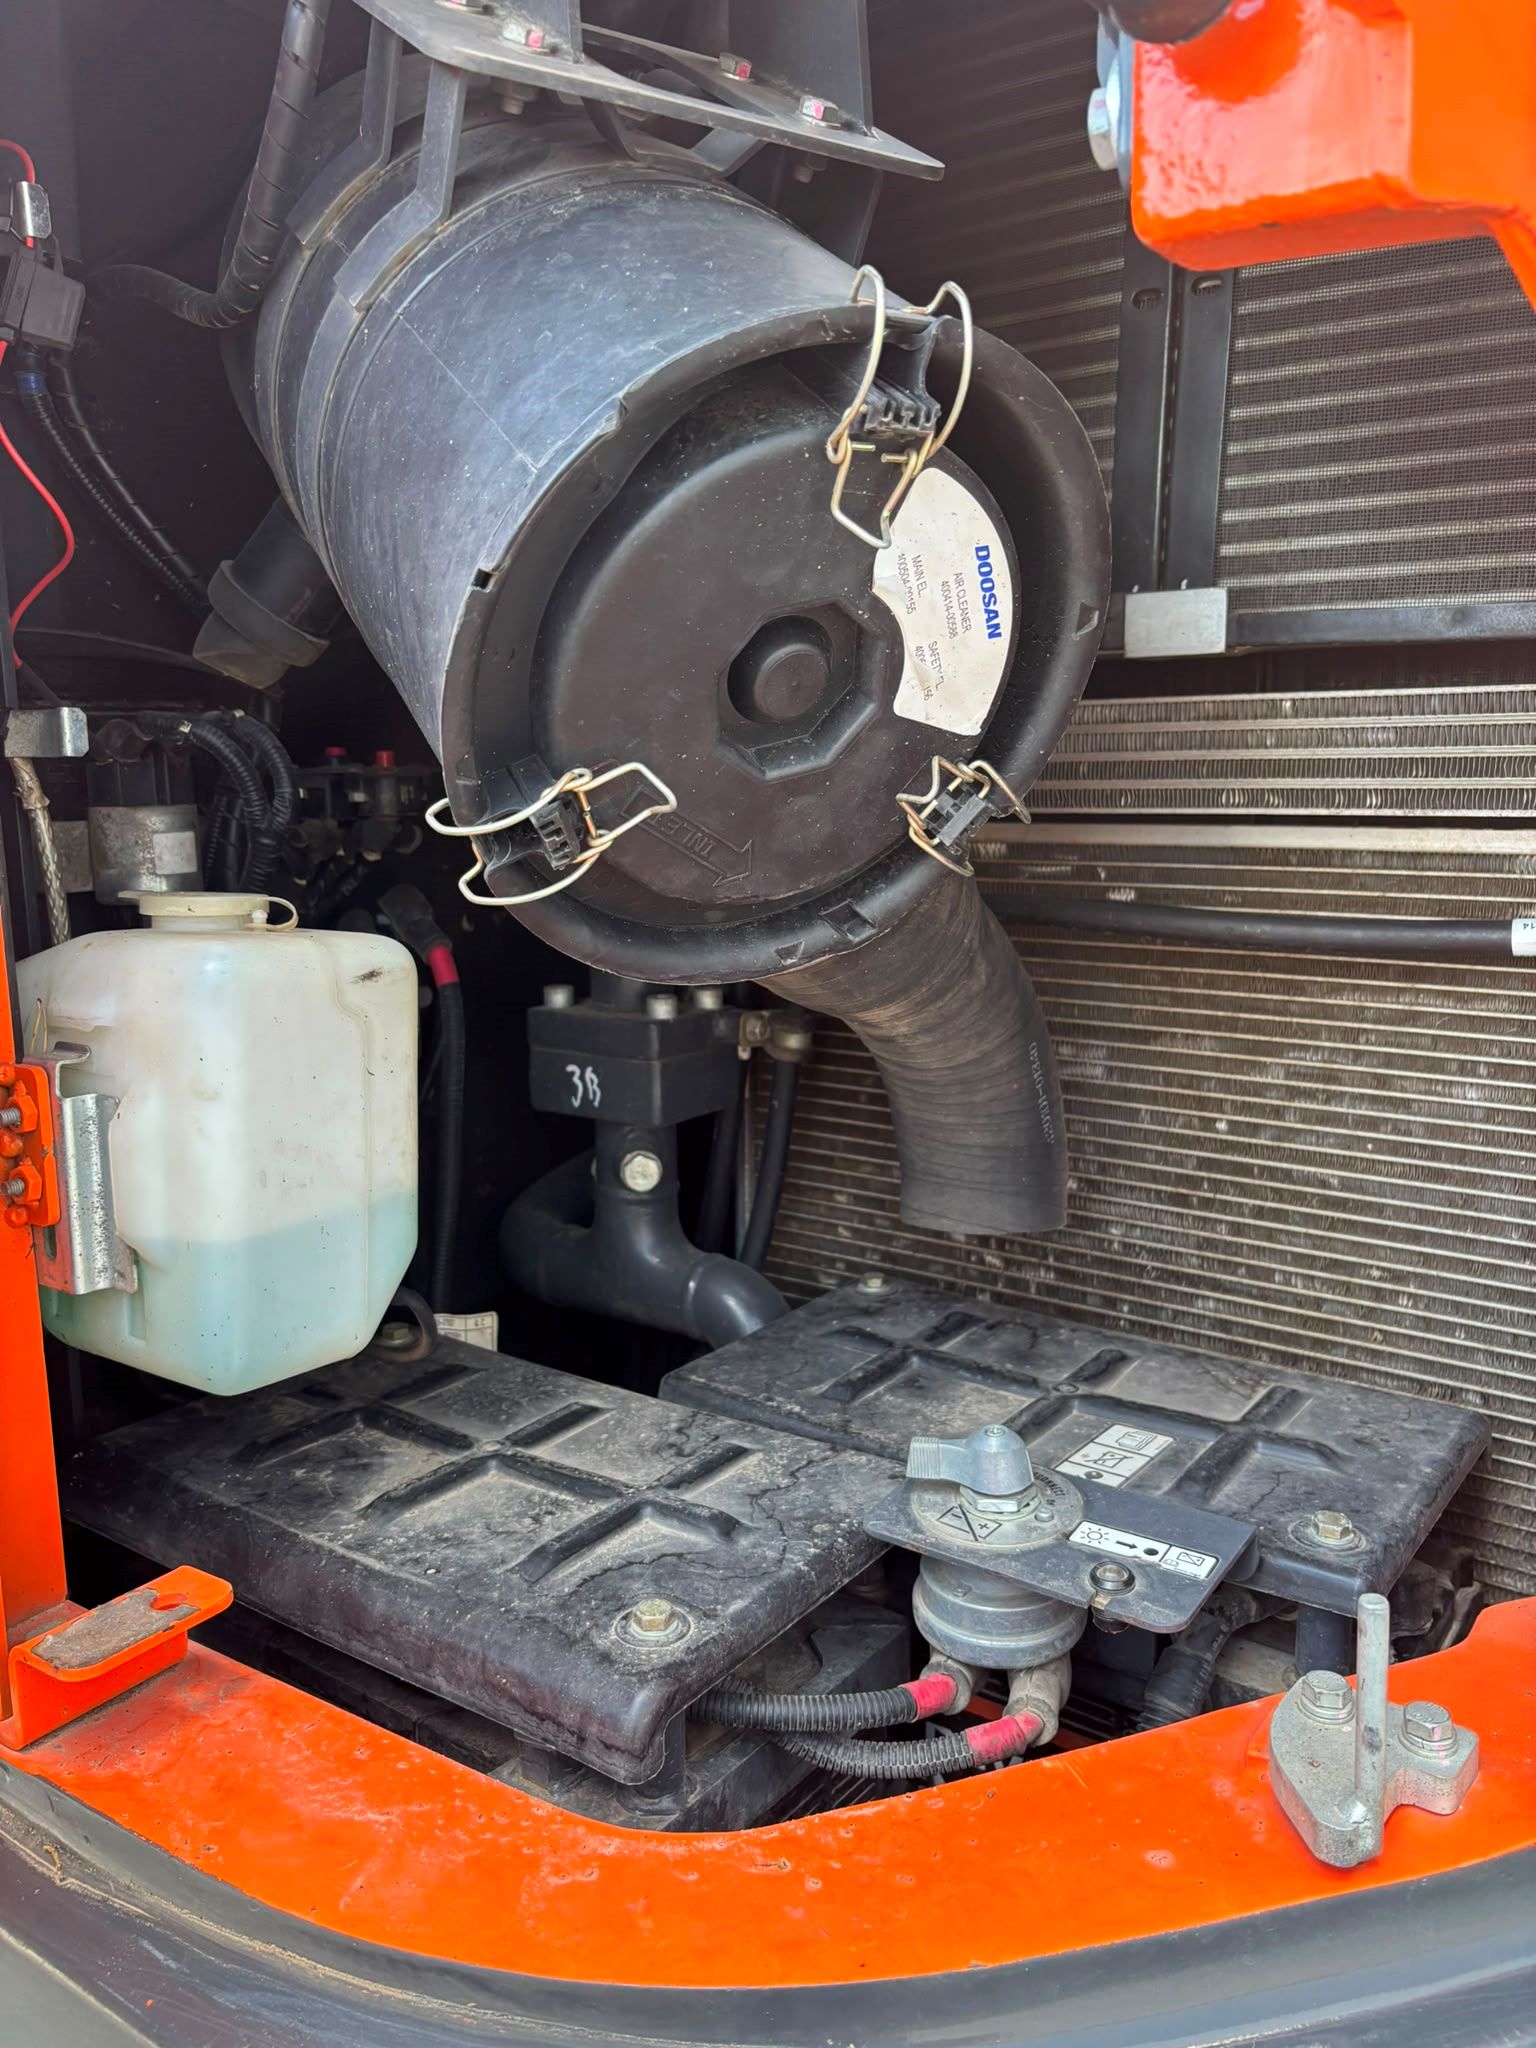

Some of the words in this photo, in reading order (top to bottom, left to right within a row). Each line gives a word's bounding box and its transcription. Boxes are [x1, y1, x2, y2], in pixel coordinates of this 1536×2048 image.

[911, 554, 924, 583] MAIN
[953, 571, 965, 590] AIR
[974, 544, 1002, 640] DOOSAN
[956, 588, 972, 635] CLEANER
